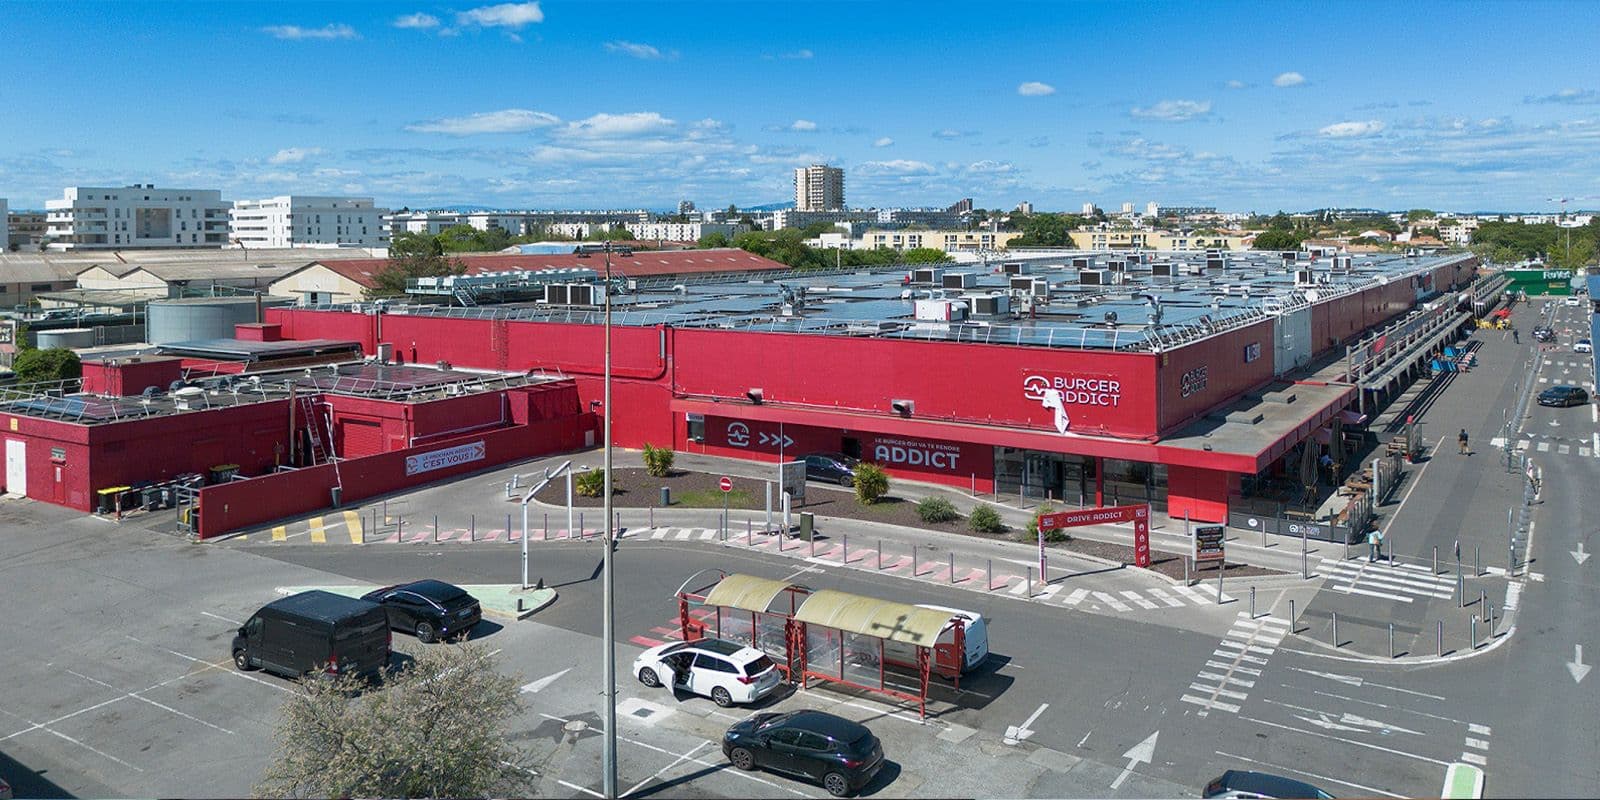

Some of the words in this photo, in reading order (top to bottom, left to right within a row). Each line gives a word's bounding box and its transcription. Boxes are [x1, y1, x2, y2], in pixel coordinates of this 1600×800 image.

[1053, 377, 1120, 393] BURGER
[883, 438, 906, 446] BURGER
[935, 444, 961, 452] RENDRE
[423, 457, 446, 469] C'EST
[447, 453, 469, 463] VOUS
[875, 445, 960, 469] ADDICT
[1066, 513, 1091, 523] DRIVE
[1093, 511, 1123, 521] ADDICT
